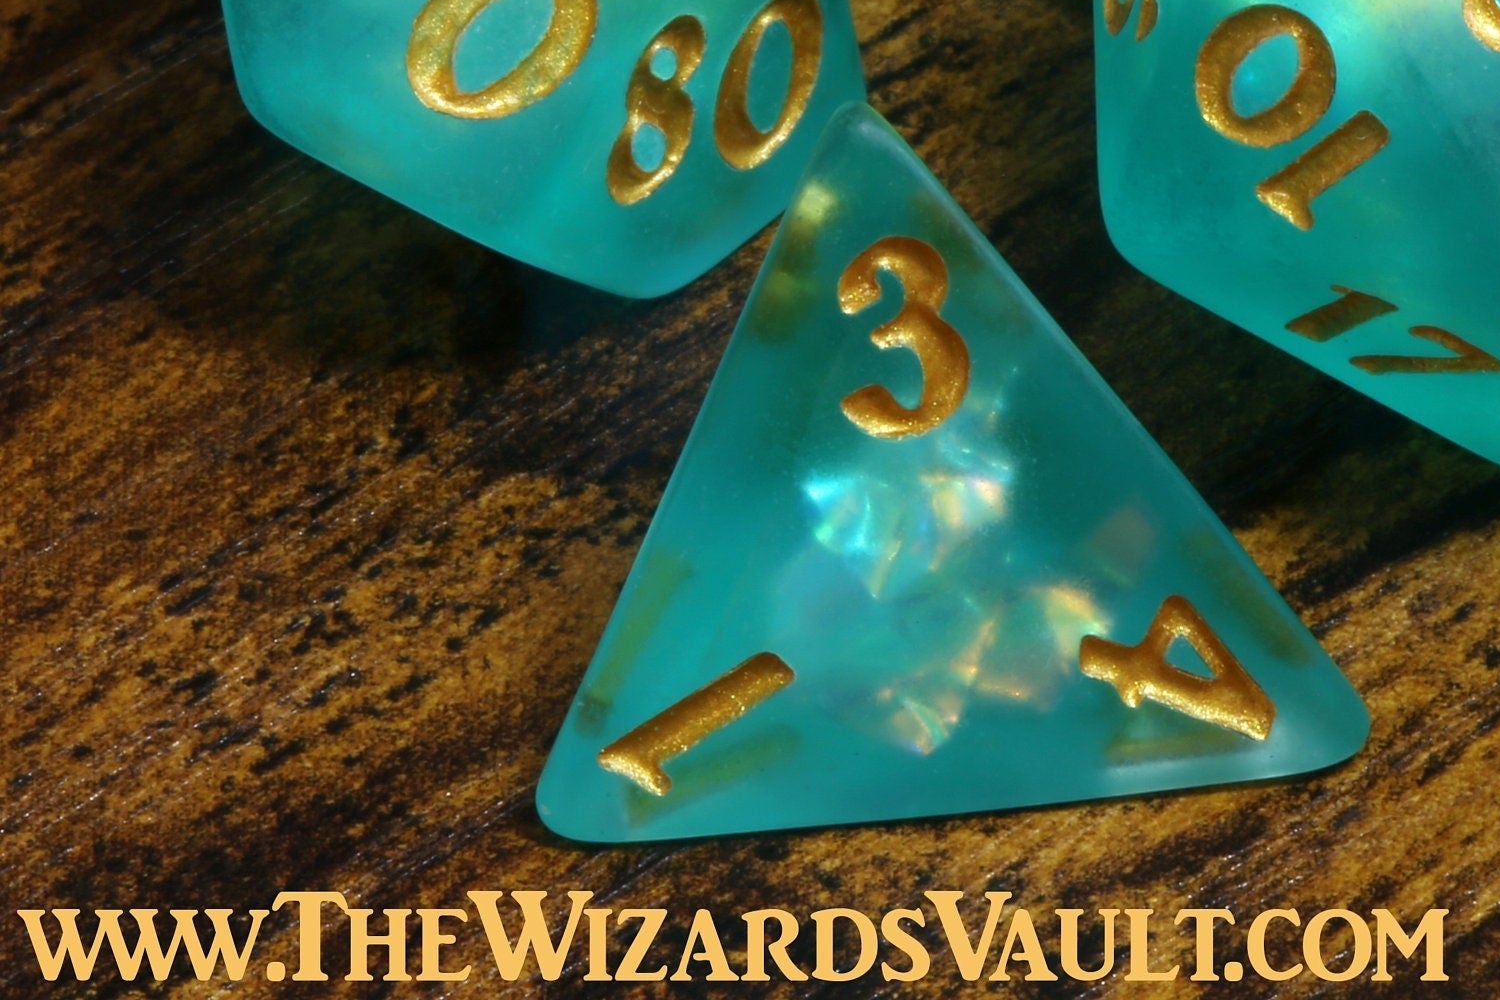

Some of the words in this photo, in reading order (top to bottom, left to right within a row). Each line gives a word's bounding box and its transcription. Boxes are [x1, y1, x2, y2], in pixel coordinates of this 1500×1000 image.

[1194, 4, 1391, 232] 10
[837, 235, 970, 440] 3
[599, 651, 796, 797] 1
[1078, 594, 1276, 741] 4
